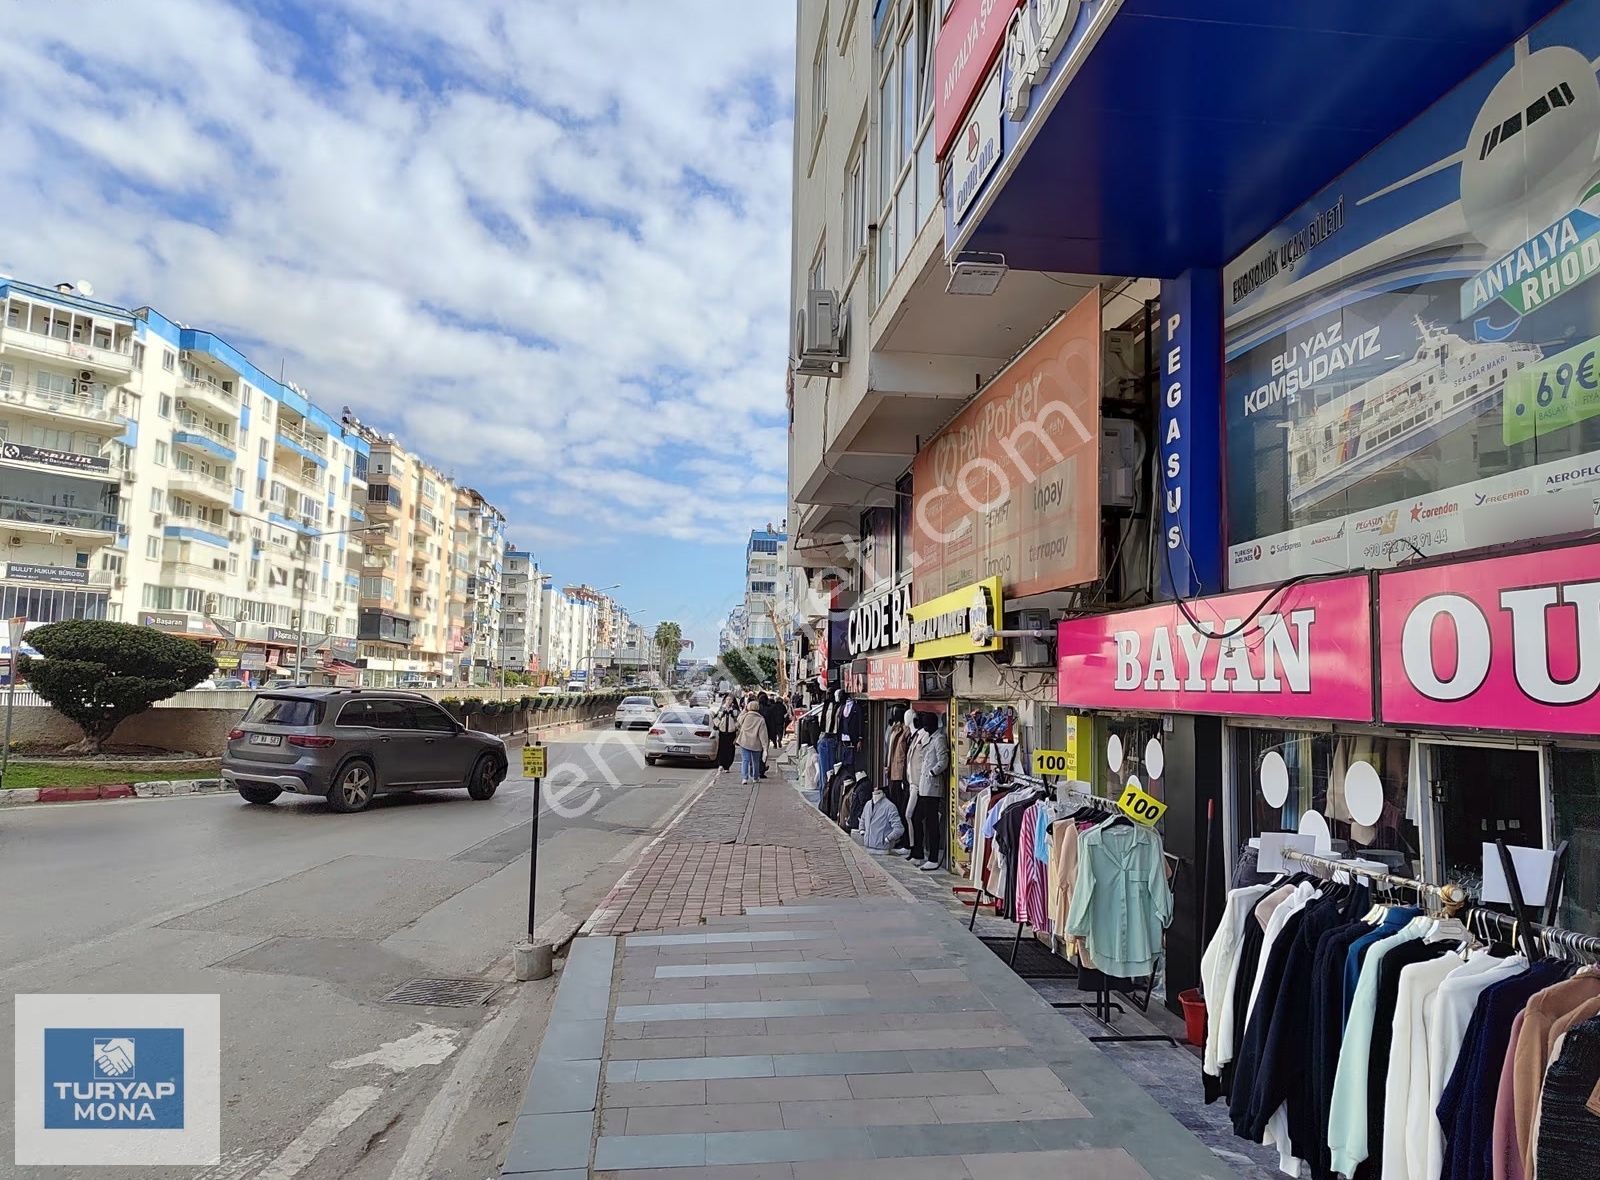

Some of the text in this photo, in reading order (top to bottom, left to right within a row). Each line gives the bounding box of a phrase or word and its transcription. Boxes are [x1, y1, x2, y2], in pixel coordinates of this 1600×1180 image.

[943, 17, 979, 108] ANTALYA
[1232, 194, 1344, 304] EKONOMİK UÇAK BİLETİ
[1472, 217, 1580, 310] ANTALYA
[1271, 321, 1342, 377] BU YAZ
[1244, 325, 1381, 417] KOMŞUDAYIZ
[1166, 313, 1183, 550] PEGASUS
[1033, 477, 1064, 512] inpay
[1421, 502, 1458, 519] corendon
[1356, 515, 1384, 530] PEGASUS
[11, 565, 33, 573] BULUT
[34, 567, 56, 575] HUKUK
[1234, 548, 1253, 558] TURKISH
[1234, 555, 1253, 564] AIRLINES
[156, 617, 183, 626] Başaran
[848, 594, 889, 656] CADDE
[1113, 608, 1316, 694] BAYAN
[1036, 755, 1066, 771] 100
[1125, 792, 1161, 820] 100
